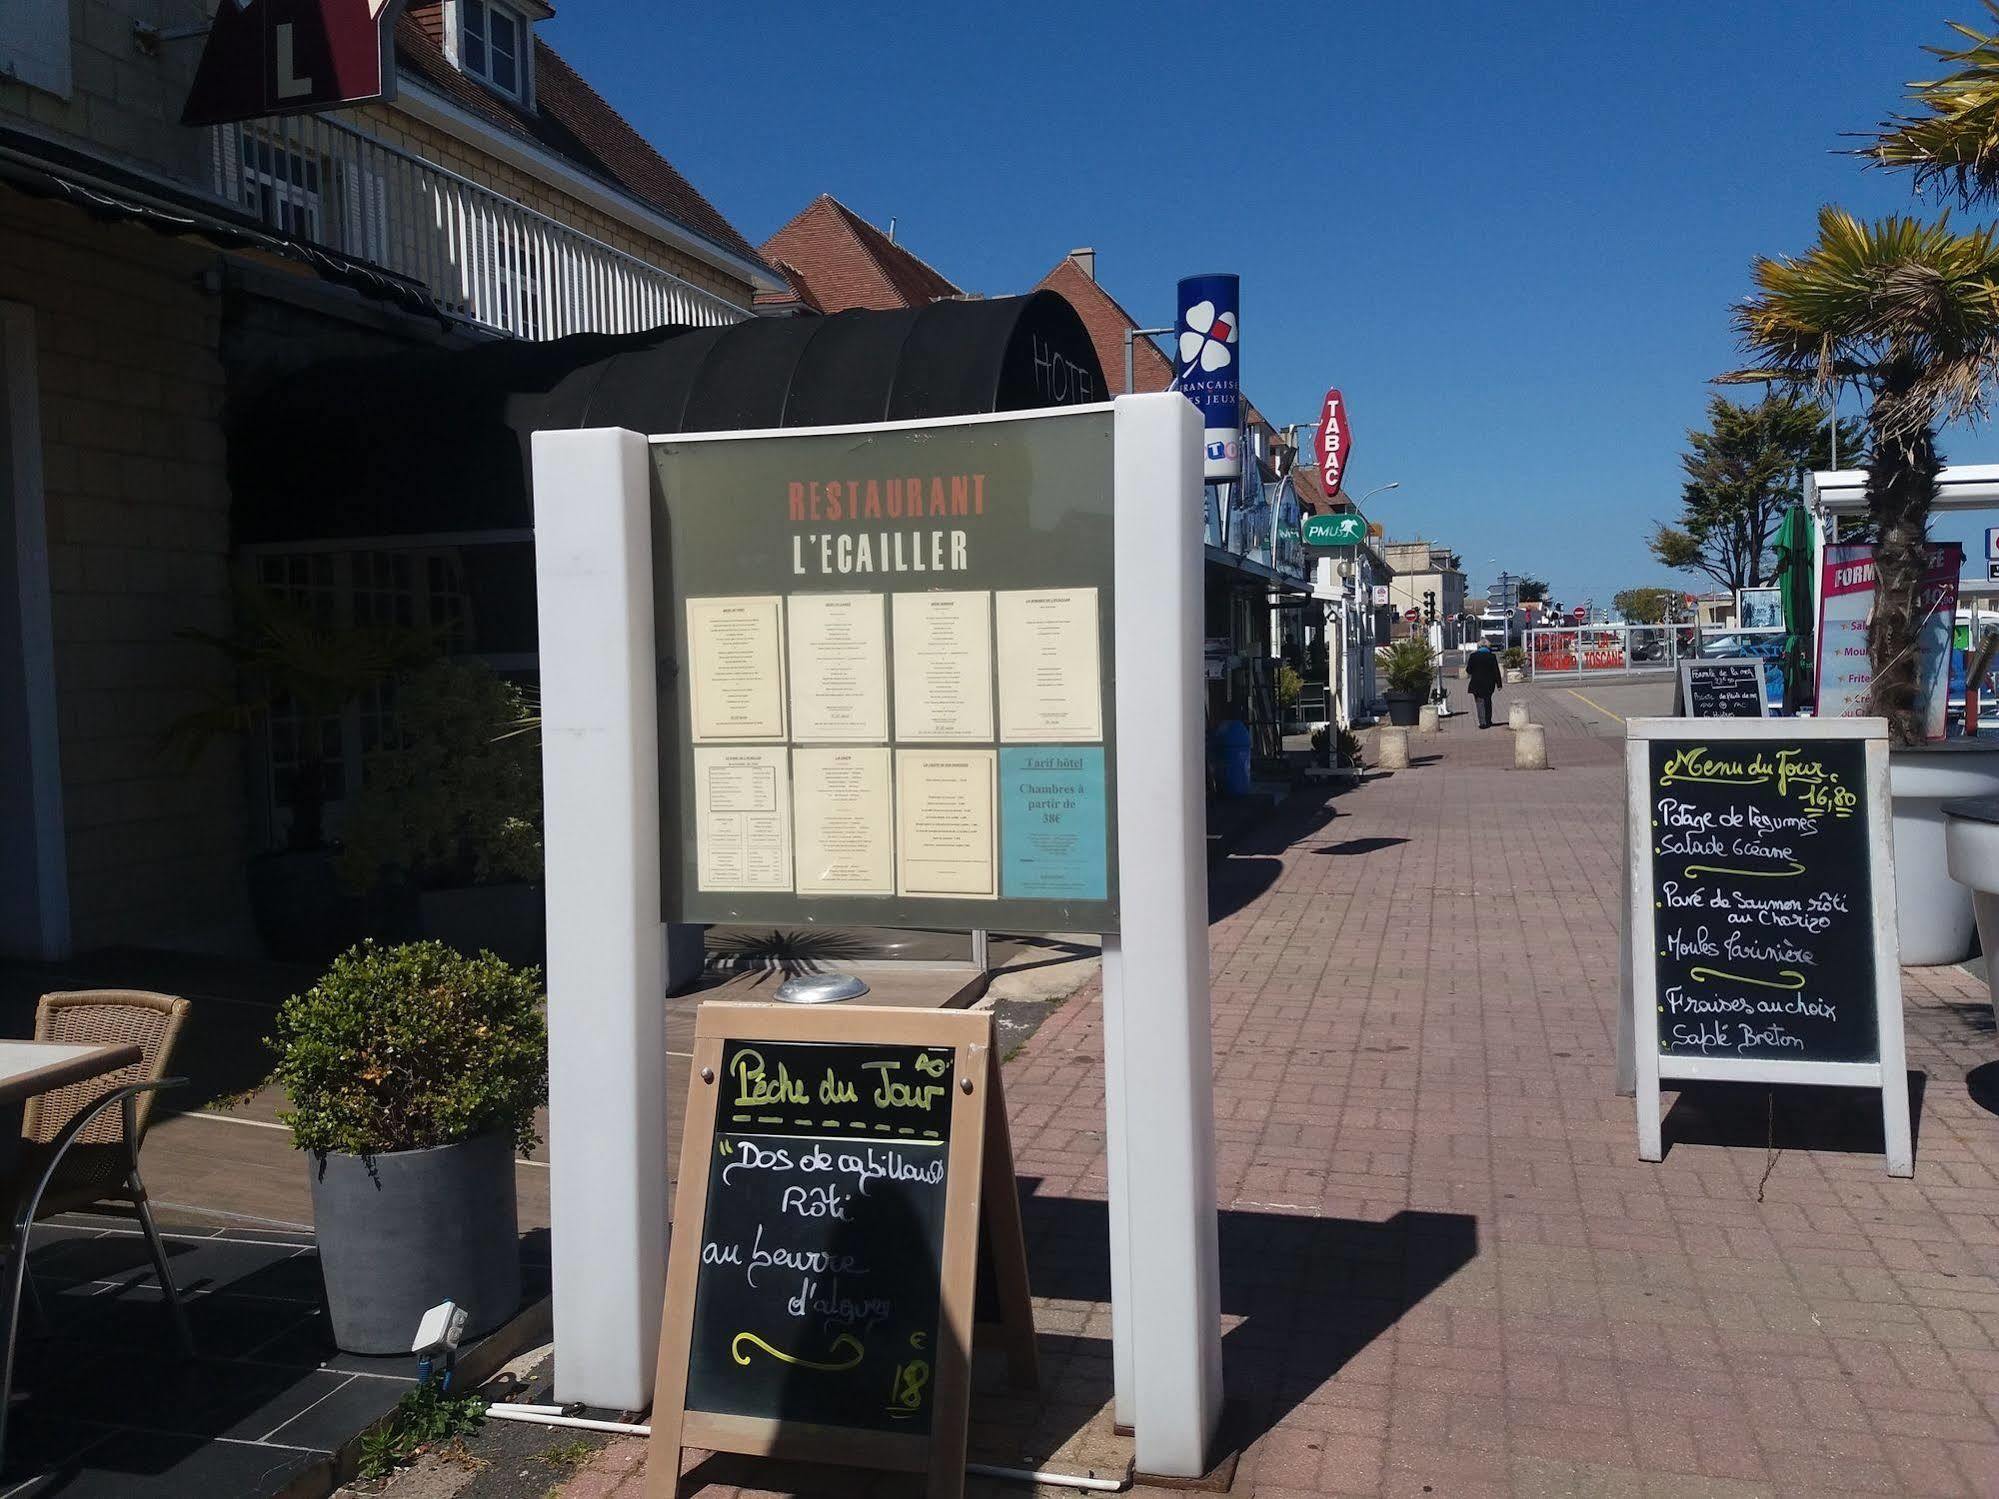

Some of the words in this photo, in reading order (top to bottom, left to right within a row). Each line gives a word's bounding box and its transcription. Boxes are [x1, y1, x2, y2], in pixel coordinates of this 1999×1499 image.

[1206, 395, 1236, 405] JEUX
[1325, 400, 1340, 486] TABAC
[788, 474, 986, 520] RESTAURANT
[1308, 526, 1339, 537] PMU
[793, 530, 968, 575] L'ECAILLER
[1835, 564, 1876, 588] FORM
[1584, 651, 1624, 668] TOSCANE
[1025, 758, 1055, 768] Tarif
[1057, 757, 1084, 768] hôtel
[1664, 747, 1743, 776] Menu
[1748, 753, 1773, 776] du
[1019, 784, 1075, 794] Chambres
[1078, 784, 1085, 794] à
[1028, 799, 1061, 811] partir
[1063, 799, 1076, 809] de
[1719, 804, 1744, 828] de
[1659, 833, 1728, 857] Salade
[1663, 881, 1705, 908] Pavé
[1710, 888, 1731, 909] de
[1732, 891, 1802, 912] Saumon
[1807, 892, 1849, 913] rôti
[1727, 912, 1753, 924] au
[1667, 926, 1720, 960] Moules
[1665, 985, 1755, 1015] Fraises
[1756, 1001, 1784, 1013] au
[1785, 991, 1837, 1022] choix
[1671, 1020, 1732, 1055] Sablé
[1737, 1023, 1804, 1055] Breton
[819, 1067, 858, 1105] du
[861, 1061, 945, 1111] Jour
[800, 1143, 834, 1172] de
[702, 1241, 743, 1265] au
[747, 1223, 870, 1289] beurre
[892, 1359, 930, 1408] 18
